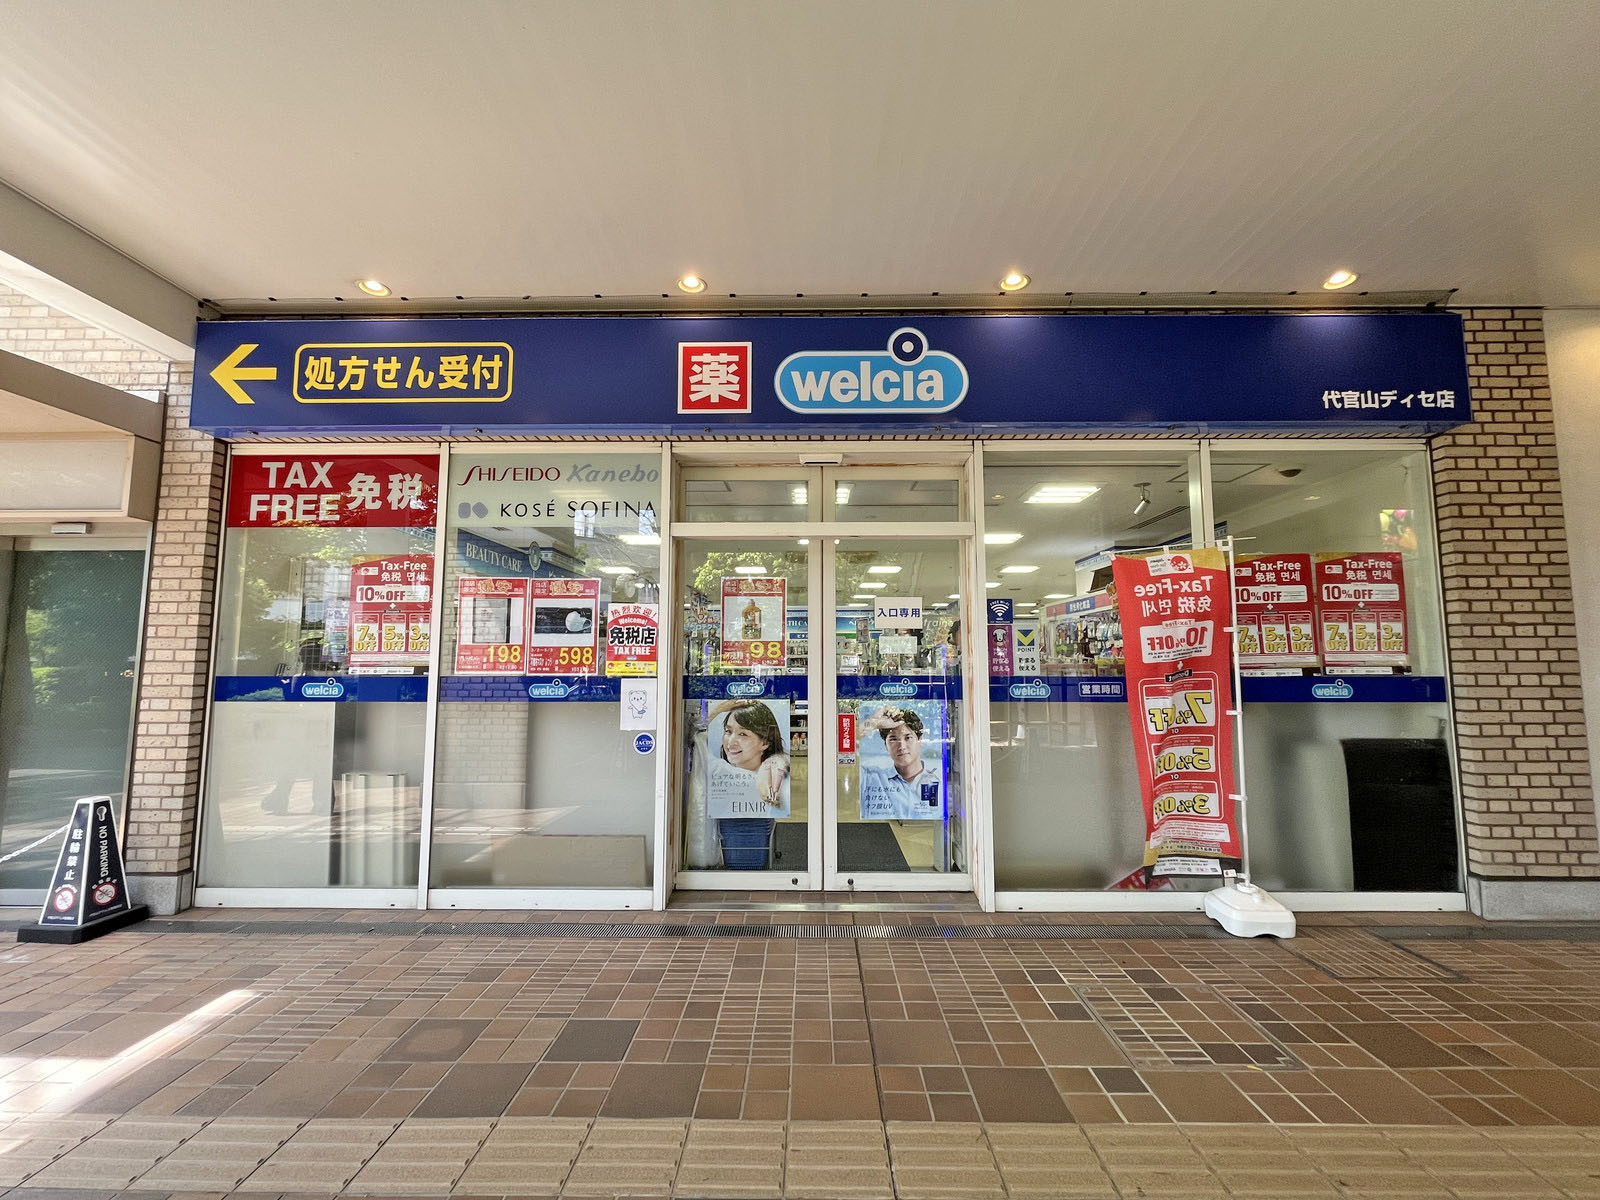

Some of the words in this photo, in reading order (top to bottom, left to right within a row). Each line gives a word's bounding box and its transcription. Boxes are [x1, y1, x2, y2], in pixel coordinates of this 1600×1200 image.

[304, 353, 503, 393] 処方せん受付
[688, 352, 741, 403] 薬
[790, 360, 944, 403] welcia
[1322, 390, 1455, 409] 代官山ディセ店
[262, 461, 334, 489] TAX
[457, 465, 561, 486] SHISEIDO
[566, 463, 659, 483] Kanebo
[347, 472, 422, 510] 免税
[249, 494, 341, 521] FREE
[501, 499, 555, 518] KOSÉ
[567, 500, 657, 518] SOFINA
[380, 561, 427, 571] Tax-Free
[466, 542, 500, 568] BEAUTY
[501, 553, 523, 573] CARE
[1253, 561, 1301, 571] Tax-Free
[1344, 559, 1393, 569] Tax-Free
[877, 607, 921, 618] 入口専用
[609, 626, 656, 645] 免税店
[487, 645, 521, 663] 198
[559, 647, 593, 665] 598
[613, 646, 630, 656] TAX
[631, 646, 651, 656] FREE
[749, 641, 782, 659] 98
[305, 685, 340, 696] welcia
[532, 684, 565, 695] welcia
[883, 684, 914, 693] welcia
[1013, 686, 1046, 696] welcia
[1081, 684, 1121, 695] 営業時間
[1315, 687, 1349, 696] welcia
[732, 801, 766, 813] ELIXIR
[99, 825, 107, 839] NO
[99, 841, 109, 877] PARKING
